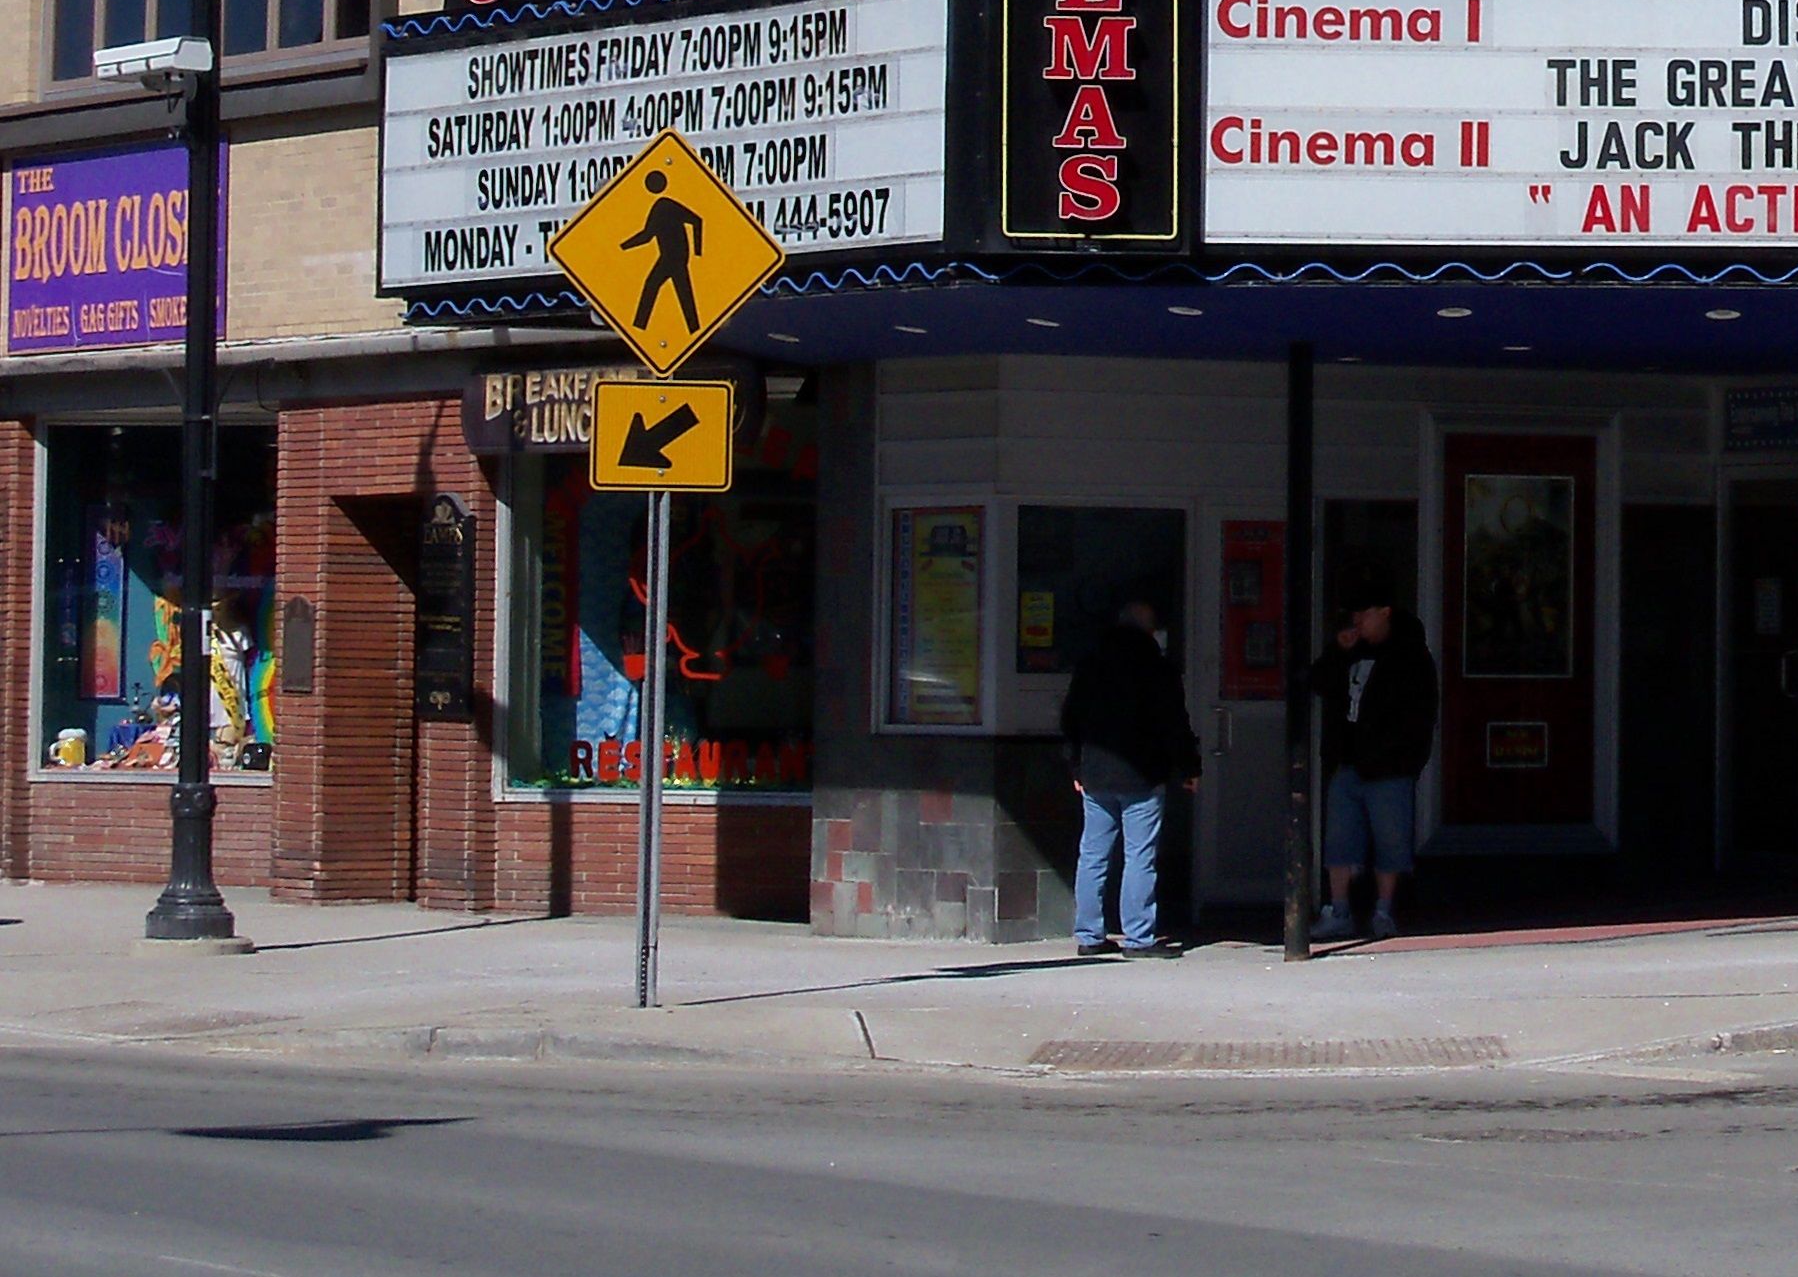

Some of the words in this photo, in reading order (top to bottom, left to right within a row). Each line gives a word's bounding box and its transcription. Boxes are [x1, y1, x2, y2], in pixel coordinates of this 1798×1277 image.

[468, 41, 590, 100] SHOWTIMES
[595, 32, 674, 82] FRIDAY
[680, 22, 761, 72] 7:00PM
[768, 9, 847, 64] 9:15PM
[1547, 59, 1636, 108] THE
[427, 107, 535, 159] SATURDAY
[541, 99, 616, 147] 1:00PM
[621, 88, 704, 138] 4:00PM
[711, 77, 796, 130] 7:00PM
[804, 64, 887, 119] 9:15PM
[1209, 116, 1434, 167] Cinema
[1560, 121, 1695, 169] JACK
[17, 168, 55, 194] THE
[478, 162, 561, 210] SUNDAY
[743, 134, 827, 187] 7:00PM
[424, 224, 518, 273] MONDAY
[774, 187, 890, 243] 444-5907
[1582, 184, 1650, 233] AN
[15, 198, 110, 284] BROOM
[114, 190, 188, 273] CLOS
[13, 304, 70, 338] NOVELTIES
[80, 302, 105, 333] GAG
[107, 299, 139, 332] GIFTS
[483, 367, 638, 421] BREAKFA
[529, 403, 592, 444] LUNC
